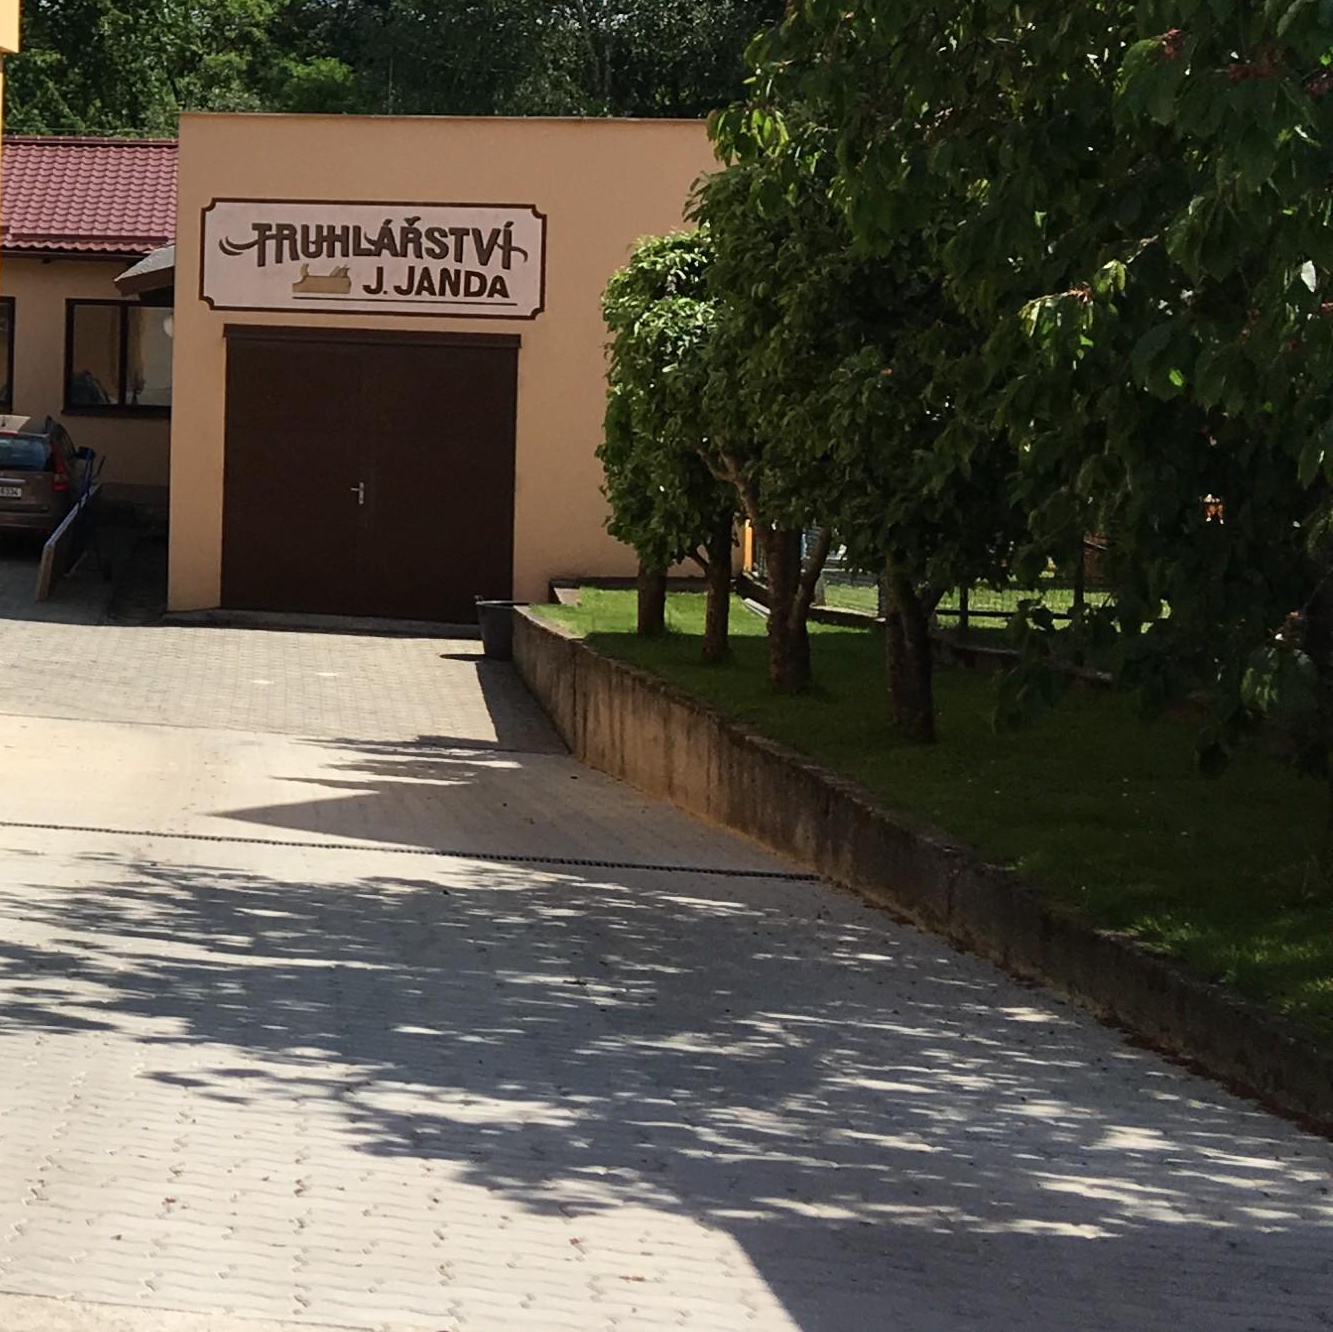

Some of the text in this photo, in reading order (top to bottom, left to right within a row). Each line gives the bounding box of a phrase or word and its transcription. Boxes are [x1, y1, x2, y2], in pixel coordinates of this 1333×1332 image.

[218, 217, 528, 269] TRUHLÁŘSTVÍ
[363, 267, 510, 299] J. JANDA
